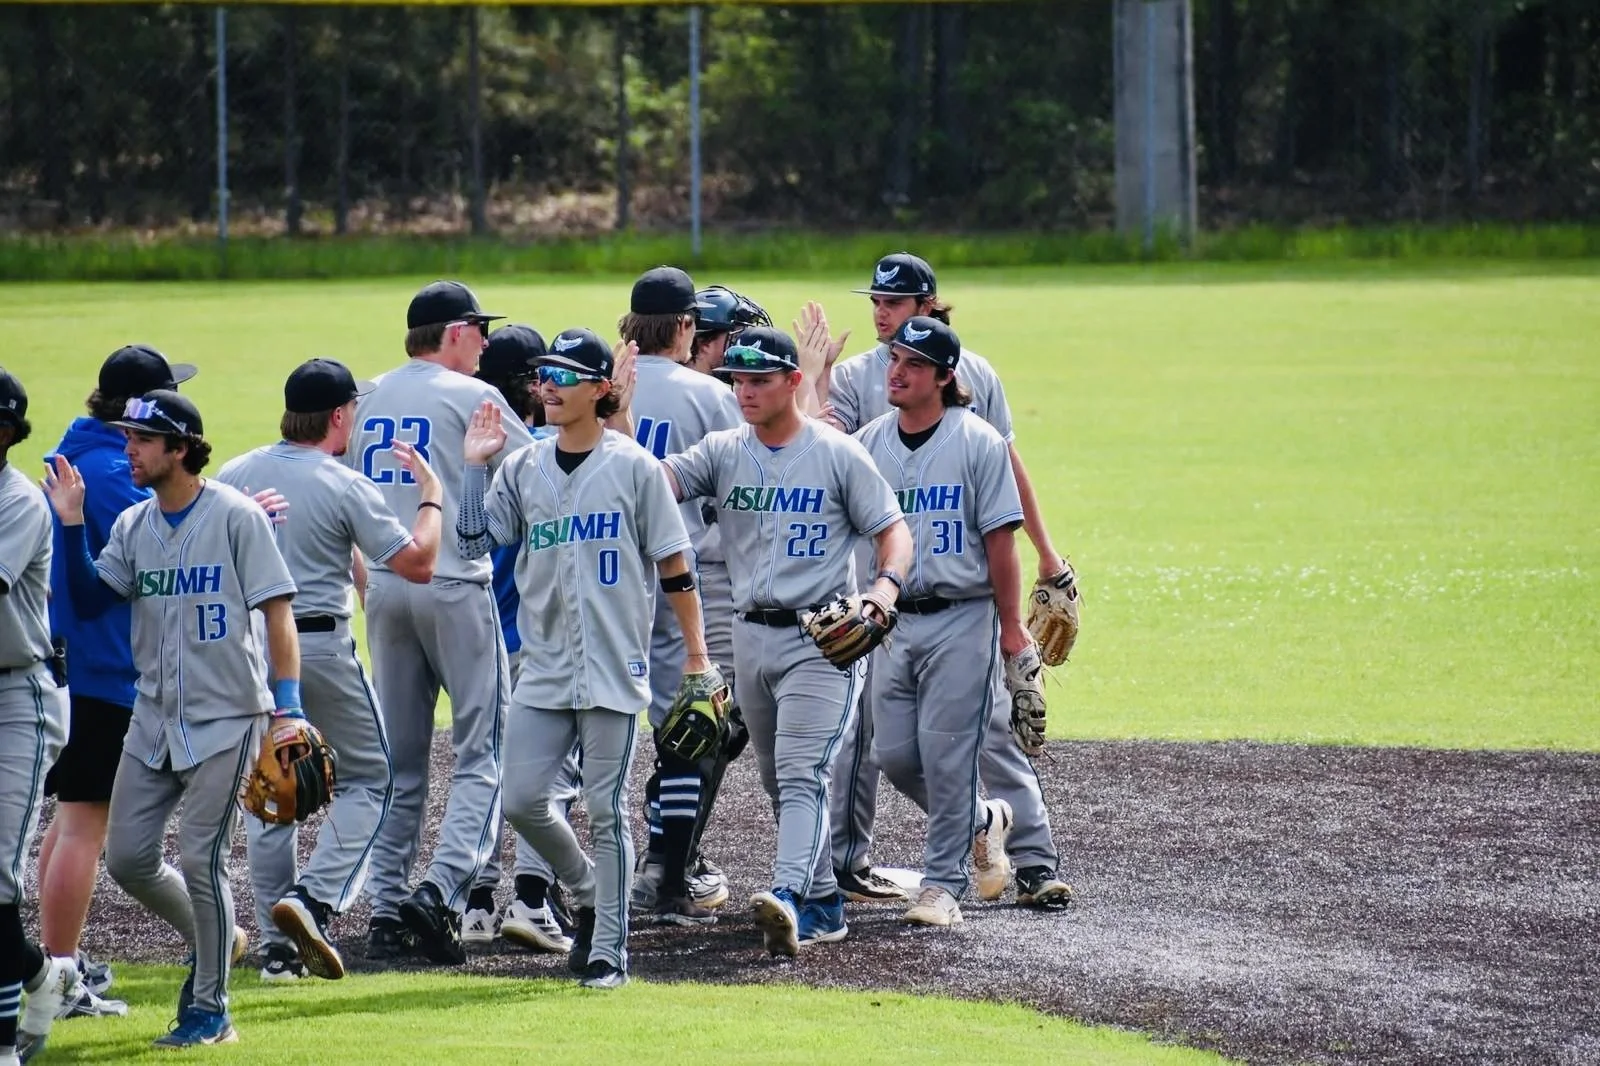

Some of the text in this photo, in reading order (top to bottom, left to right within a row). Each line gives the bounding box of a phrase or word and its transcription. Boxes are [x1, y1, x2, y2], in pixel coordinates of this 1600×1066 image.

[362, 415, 432, 486] 23
[722, 484, 826, 514] ASUMH
[892, 484, 964, 516] UMH
[528, 510, 622, 552] ASUMH
[787, 522, 828, 558] 22
[932, 520, 964, 556] 31
[598, 548, 620, 587] 0
[195, 603, 228, 643] 13
